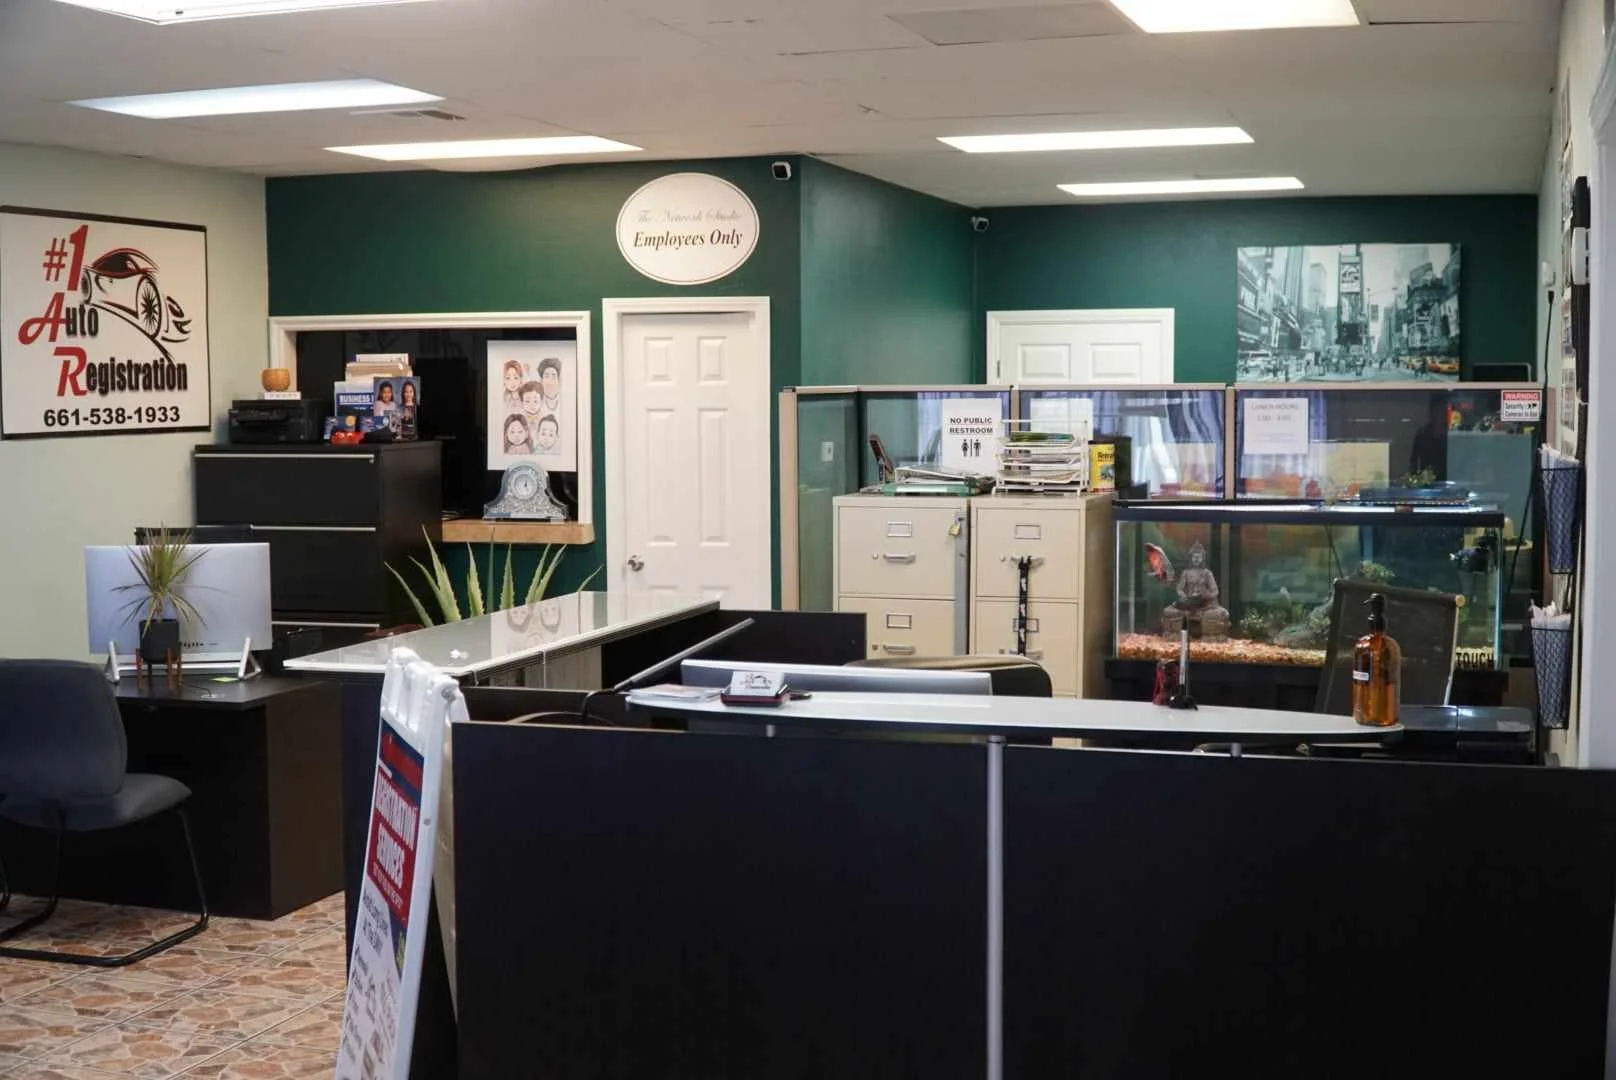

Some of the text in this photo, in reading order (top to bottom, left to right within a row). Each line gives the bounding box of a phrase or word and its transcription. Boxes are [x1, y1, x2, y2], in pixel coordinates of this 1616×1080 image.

[634, 229, 743, 250] Employees Only
[43, 224, 88, 291] #1
[18, 292, 99, 345] Auto
[53, 346, 187, 397] Registration
[340, 394, 370, 404] BUSINESS
[1504, 392, 1538, 400] WARNING
[43, 406, 180, 427] 661-538-1933
